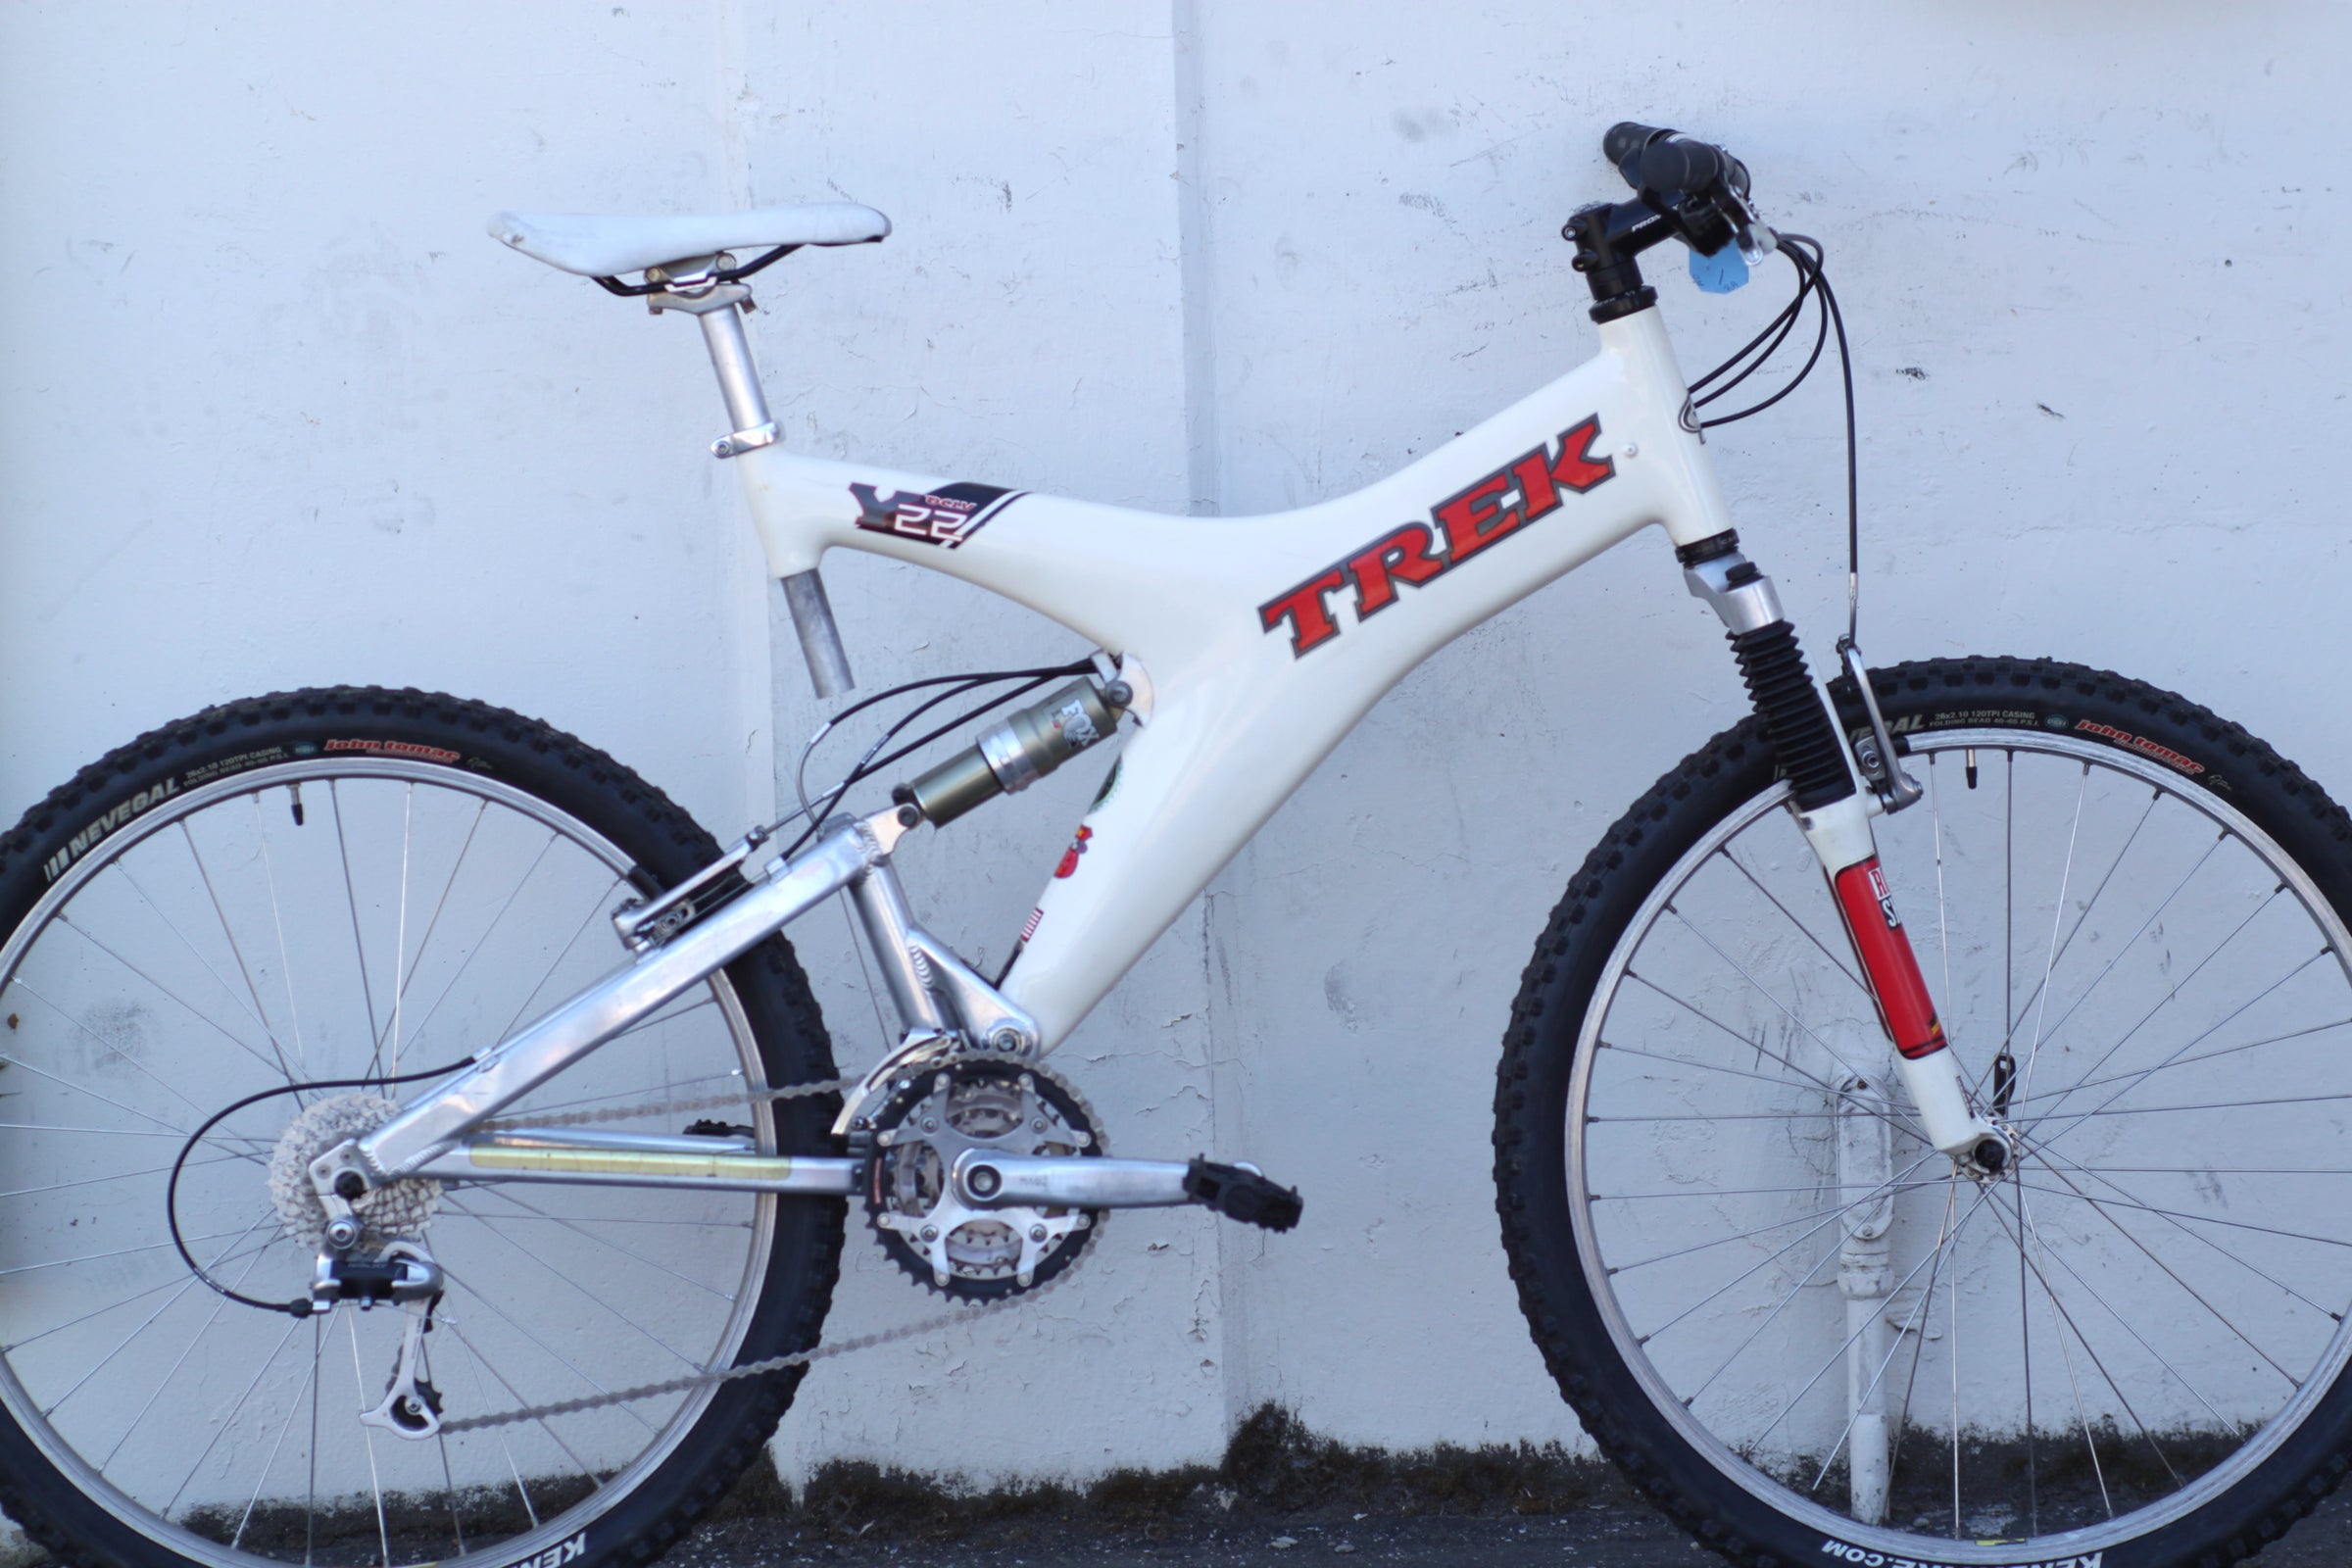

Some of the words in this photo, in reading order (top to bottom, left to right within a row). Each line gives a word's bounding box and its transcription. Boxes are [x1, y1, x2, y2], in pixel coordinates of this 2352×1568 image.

[894, 503, 968, 542] 22
[1257, 412, 1616, 660] TREK
[1930, 717, 1966, 728] FOLDING
[2002, 710, 2035, 720] CASING
[69, 777, 180, 858] NEVEGAL
